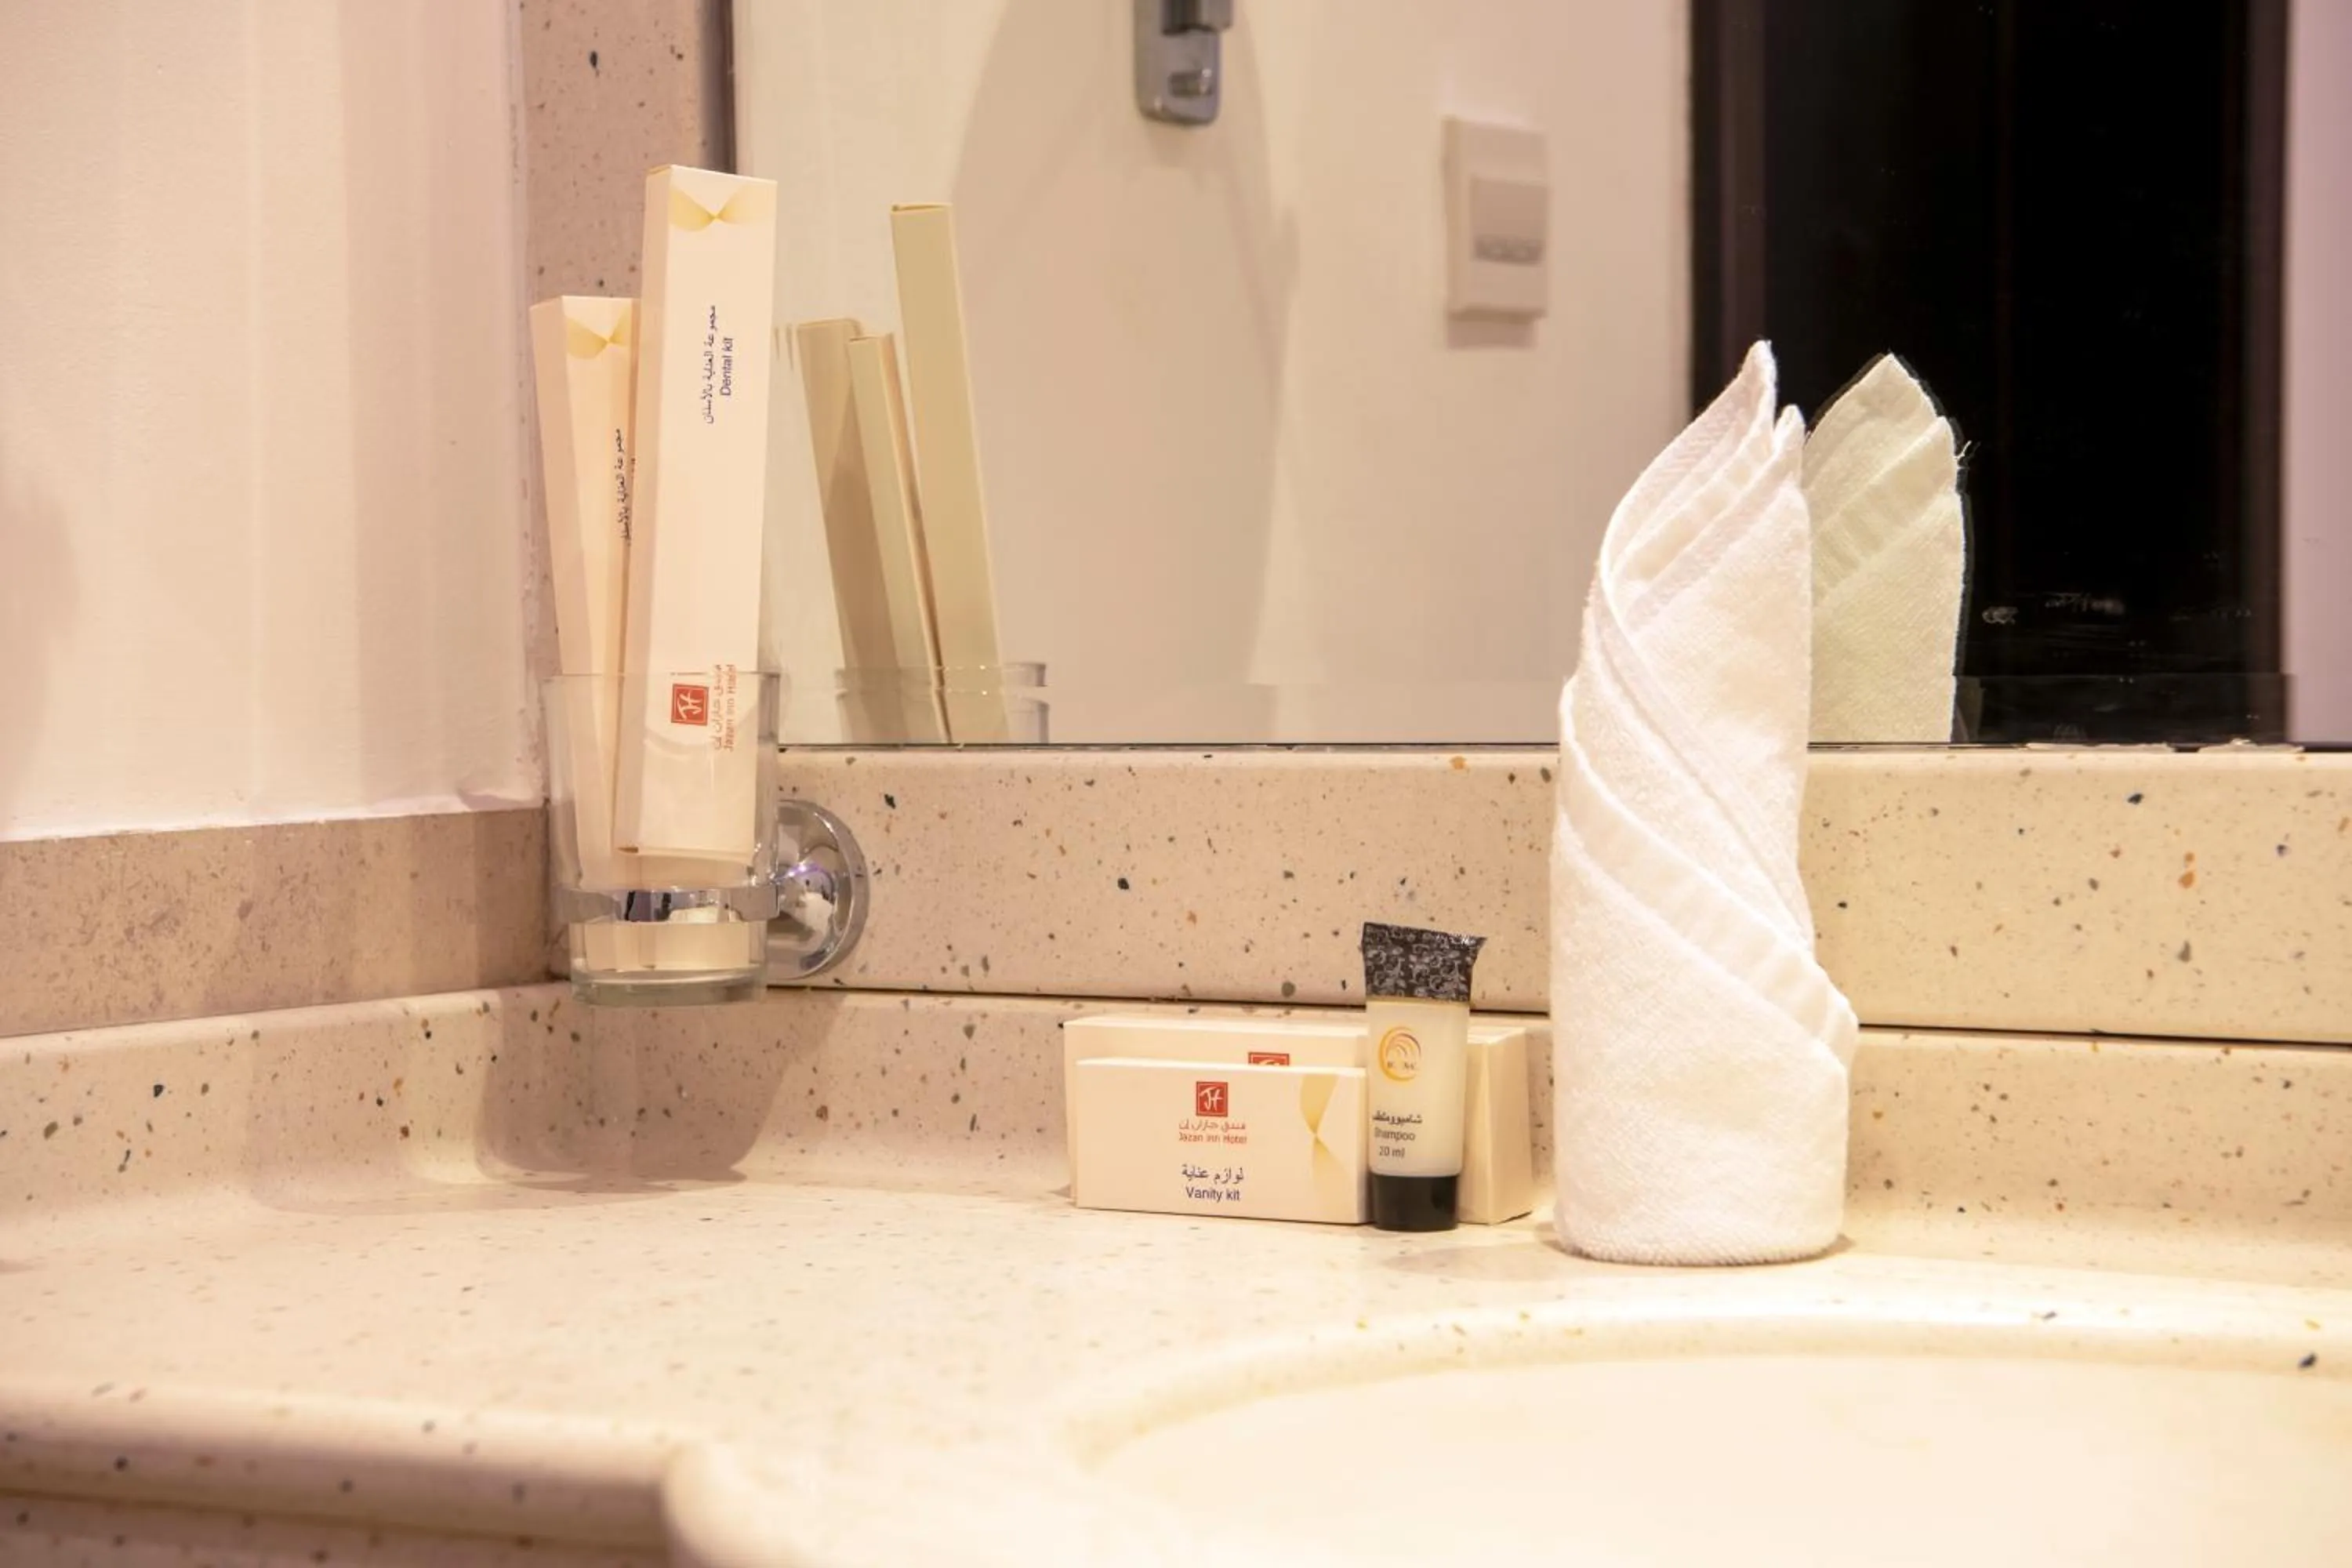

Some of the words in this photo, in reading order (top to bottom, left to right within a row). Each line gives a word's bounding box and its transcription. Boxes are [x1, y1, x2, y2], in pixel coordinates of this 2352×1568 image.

[721, 336, 734, 351] kit
[720, 355, 733, 396] Dental
[1374, 1127, 1416, 1142] Shampoo
[1379, 1145, 1390, 1156] 20
[1392, 1147, 1406, 1158] ml
[1185, 1186, 1223, 1203] Vanity
[1225, 1188, 1240, 1201] kit
